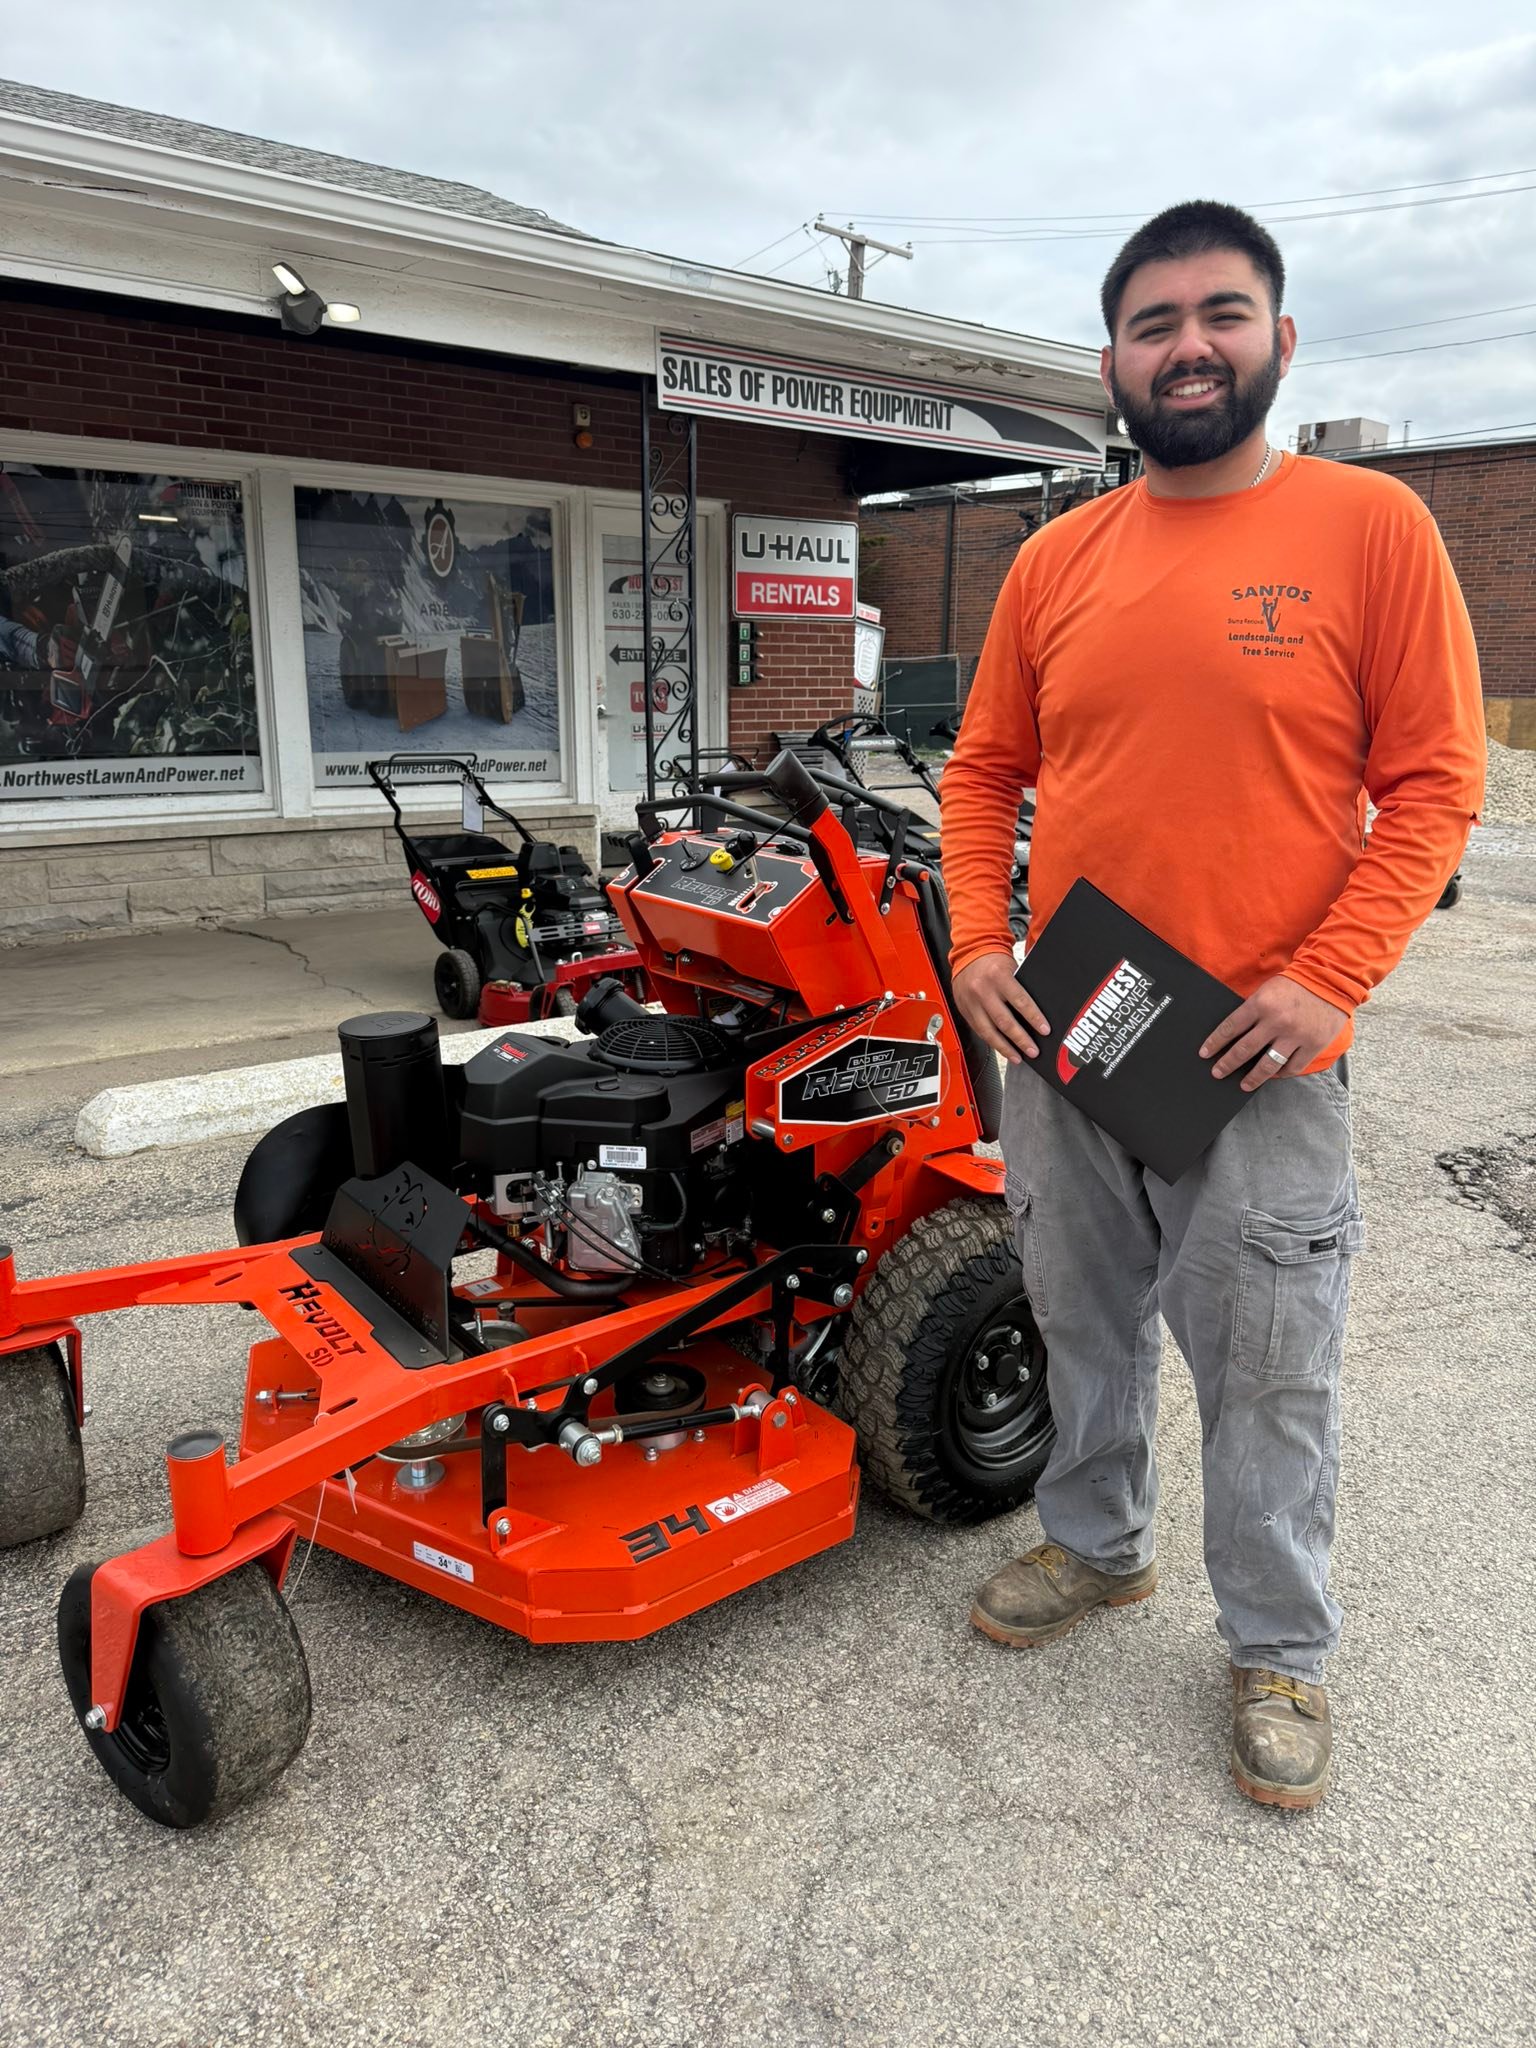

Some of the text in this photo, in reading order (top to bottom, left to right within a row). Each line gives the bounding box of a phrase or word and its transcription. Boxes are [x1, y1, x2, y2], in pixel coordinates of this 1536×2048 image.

[662, 355, 954, 431] SALES OF POWER EQUIPMENT
[181, 482, 236, 500] NORTHWEST
[741, 531, 850, 564] U-HAUL
[751, 582, 840, 606] RENTALS
[1231, 585, 1312, 602] SANTOS
[1228, 632, 1304, 645] Landscaping and
[619, 649, 681, 661] ENTANCE
[1242, 646, 1295, 659] Tree Service
[412, 879, 440, 910] TORO
[670, 875, 738, 900] REVOLT
[1063, 960, 1142, 1057] NORTHWEST
[1080, 978, 1152, 1063] LAWN & POWER
[1098, 997, 1155, 1064] EQUIPMENT
[1103, 995, 1172, 1078] northwestlawnandpower.net
[852, 1053, 890, 1066] BAD BOY
[802, 1054, 934, 1100] REVOLT
[886, 1082, 920, 1102] SD
[278, 1279, 367, 1357] REVOLT
[305, 1347, 335, 1367] SD
[742, 1478, 776, 1495] DANGER
[618, 1504, 712, 1564] 34
